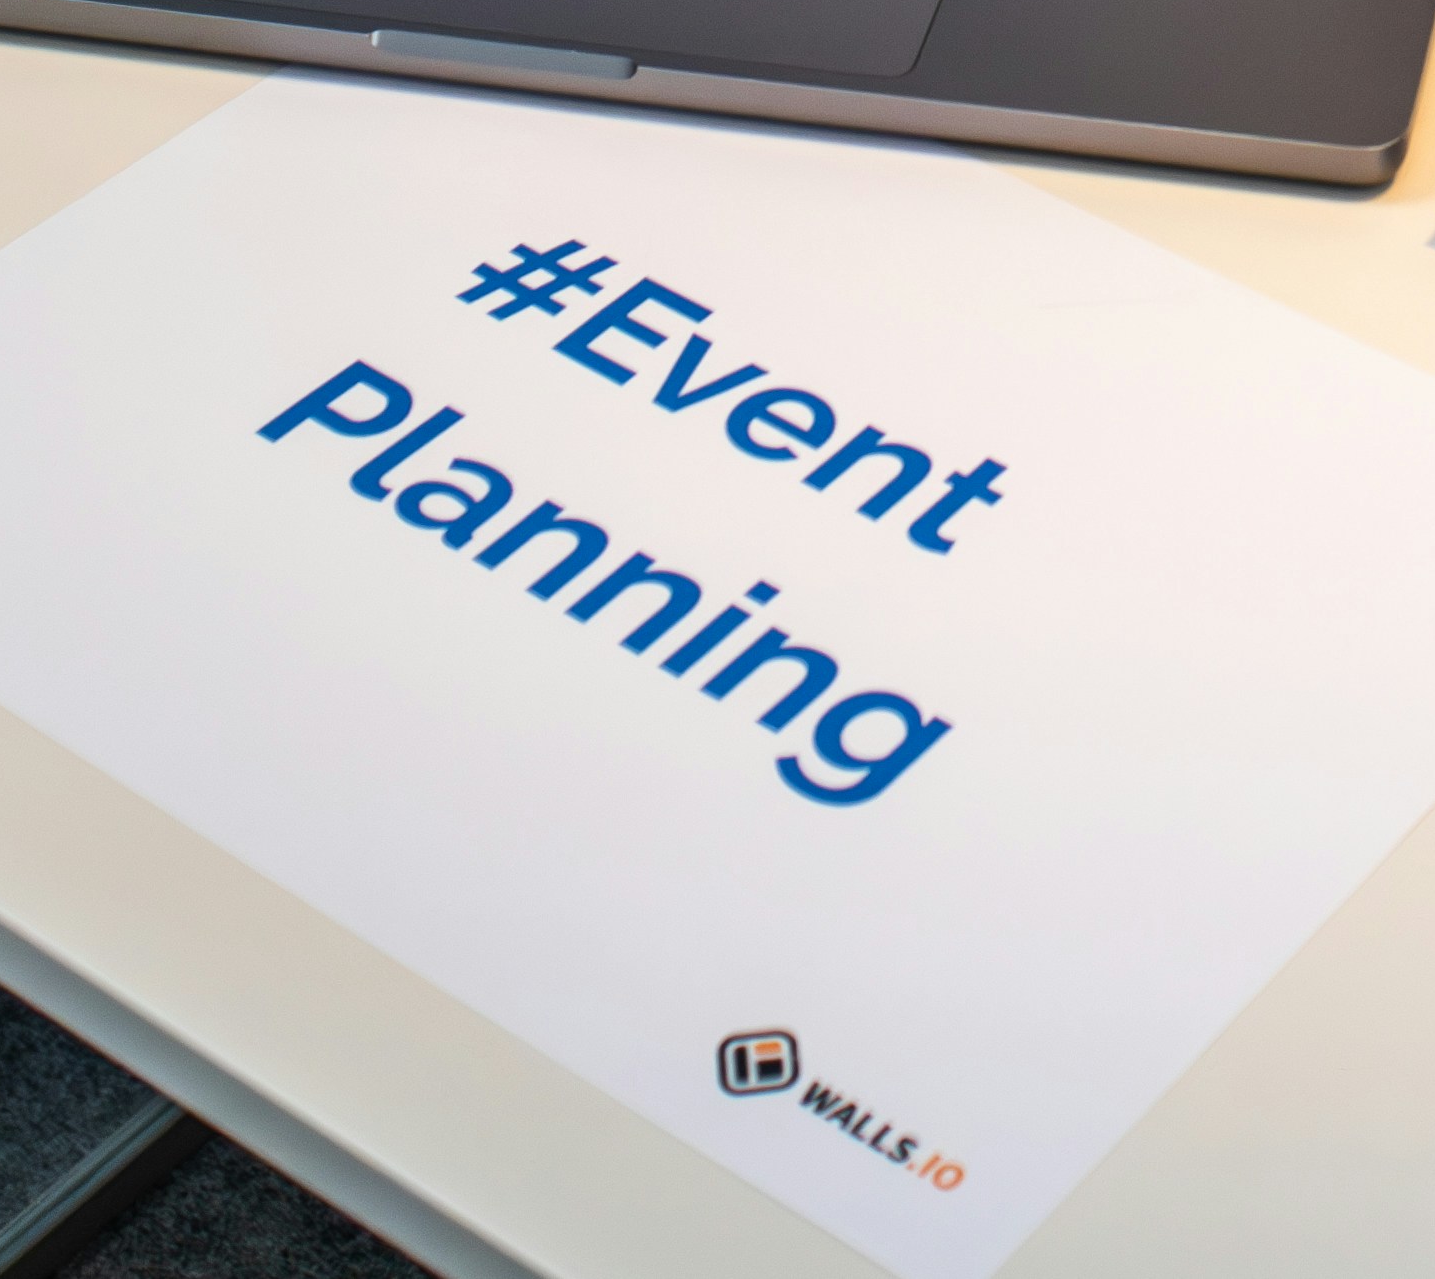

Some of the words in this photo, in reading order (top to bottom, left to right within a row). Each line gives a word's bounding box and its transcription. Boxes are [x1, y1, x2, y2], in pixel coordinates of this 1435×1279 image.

[455, 239, 1008, 557] #Event
[255, 358, 955, 808] Planning
[798, 1078, 967, 1194] WALLS.IO
